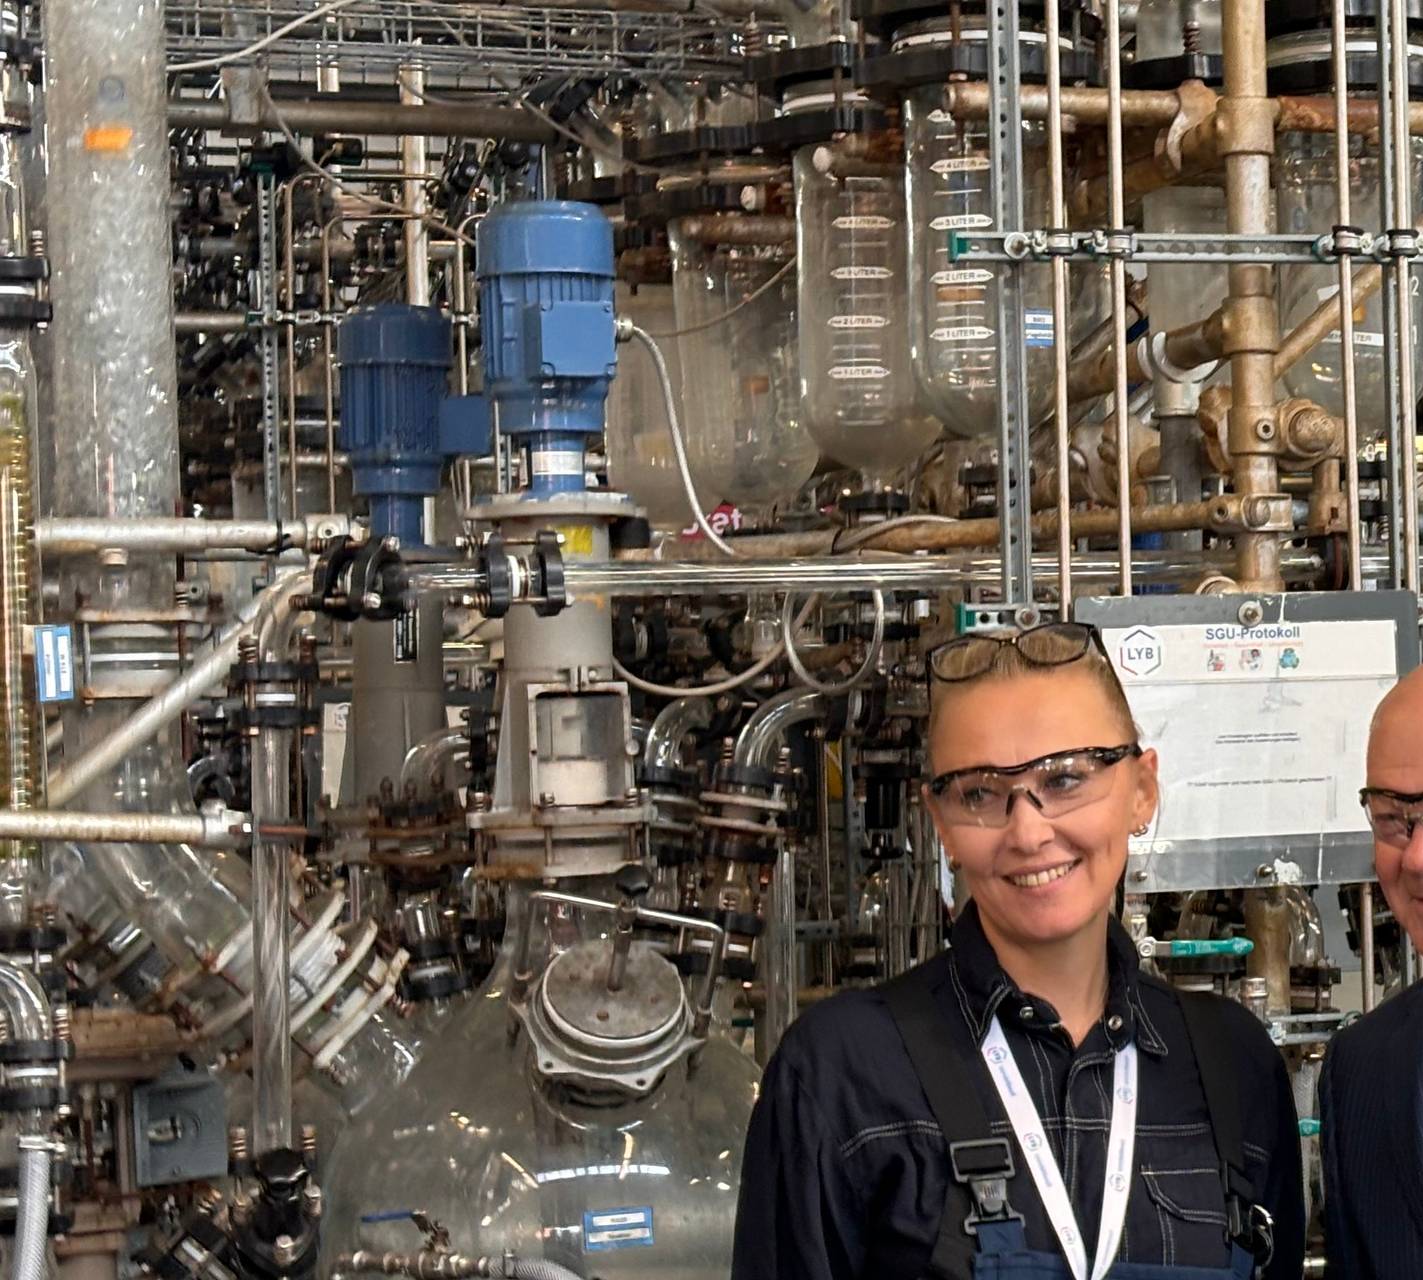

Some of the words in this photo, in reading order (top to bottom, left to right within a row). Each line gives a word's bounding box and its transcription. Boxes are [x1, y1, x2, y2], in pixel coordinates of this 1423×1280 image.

[951, 271, 975, 280] LITER
[1411, 275, 1420, 297] 2
[951, 329, 975, 338] LITER
[1205, 626, 1301, 641] SGU-Protokoll
[1127, 648, 1155, 661] LYB
